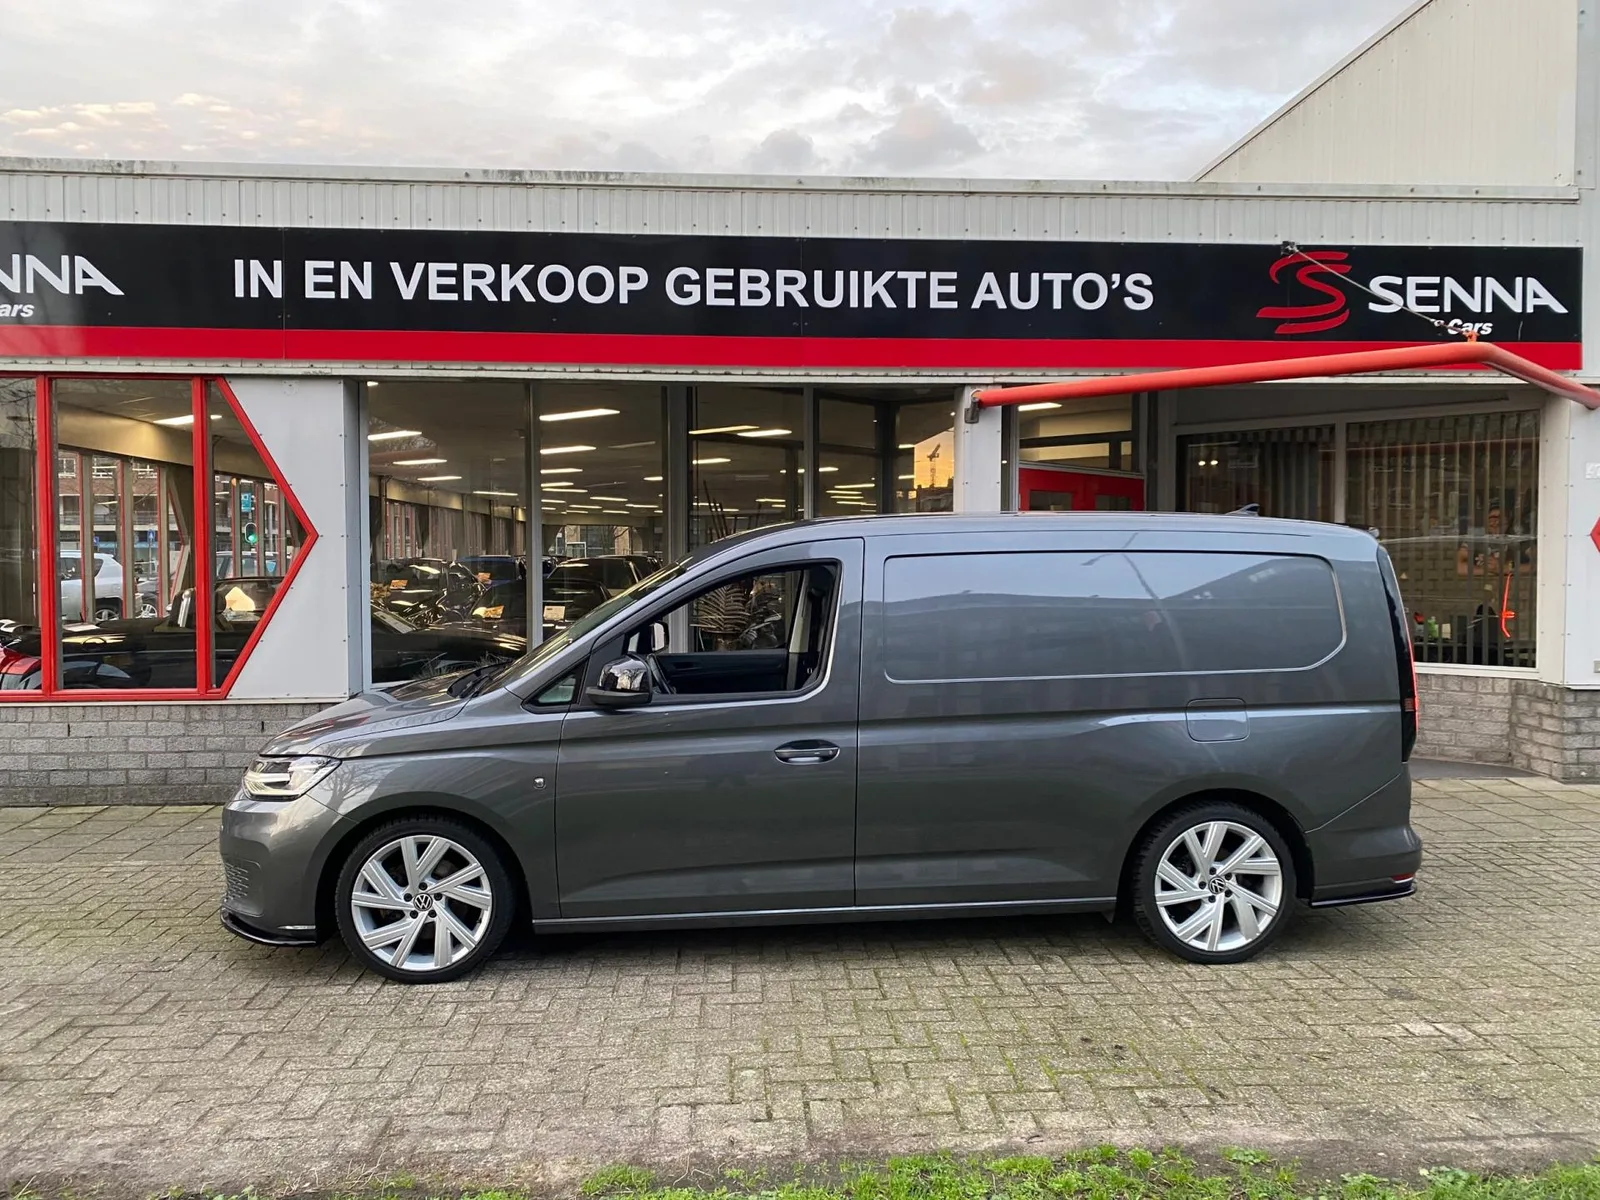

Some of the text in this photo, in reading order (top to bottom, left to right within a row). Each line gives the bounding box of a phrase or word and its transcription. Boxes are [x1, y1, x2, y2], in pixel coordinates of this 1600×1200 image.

[234, 259, 283, 299] IN
[304, 260, 372, 300] EN
[389, 261, 649, 305] VERKOOP
[665, 266, 958, 309] GEBRUIKTE
[1368, 275, 1569, 314] SENNA
[1446, 318, 1493, 336] Cars
